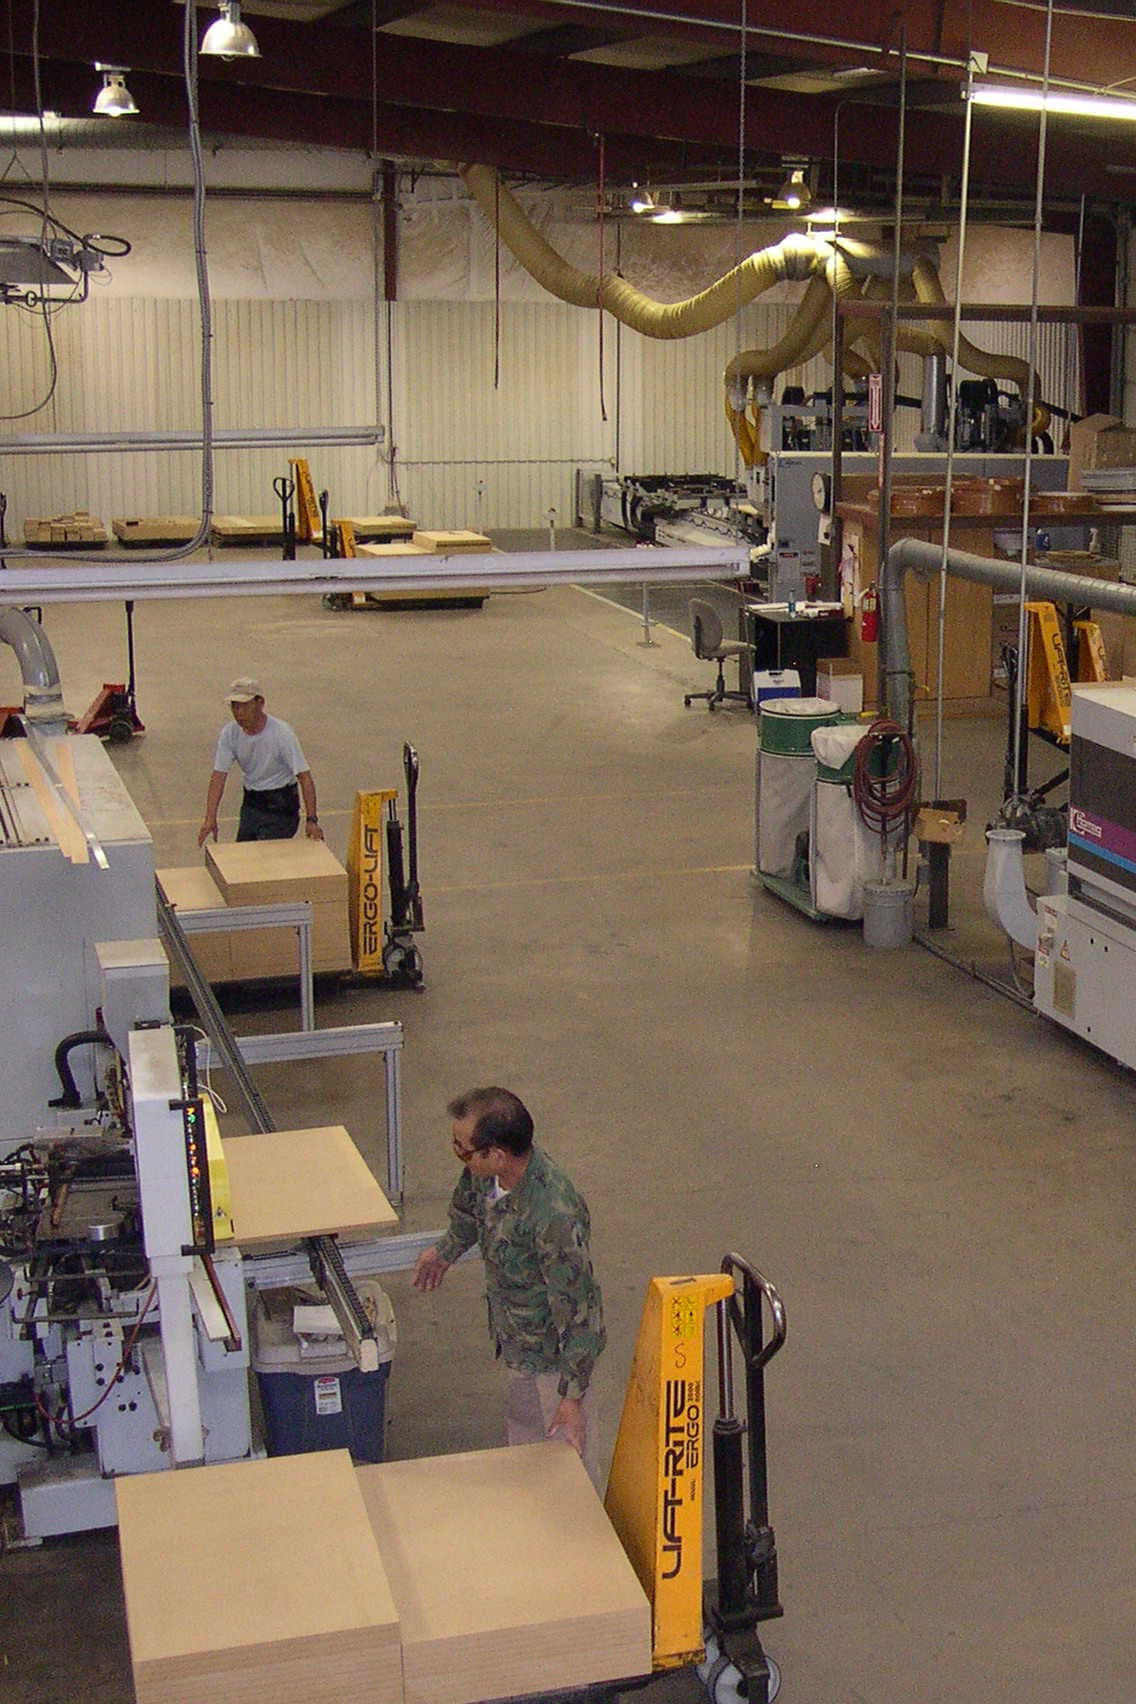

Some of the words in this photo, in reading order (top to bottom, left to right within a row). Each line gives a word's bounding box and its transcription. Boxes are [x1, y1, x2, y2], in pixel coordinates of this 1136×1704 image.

[363, 825, 379, 955] ERGO-LIFT
[662, 1380, 686, 1580] LIFT-RITE
[686, 1405, 699, 1469] ERGO
